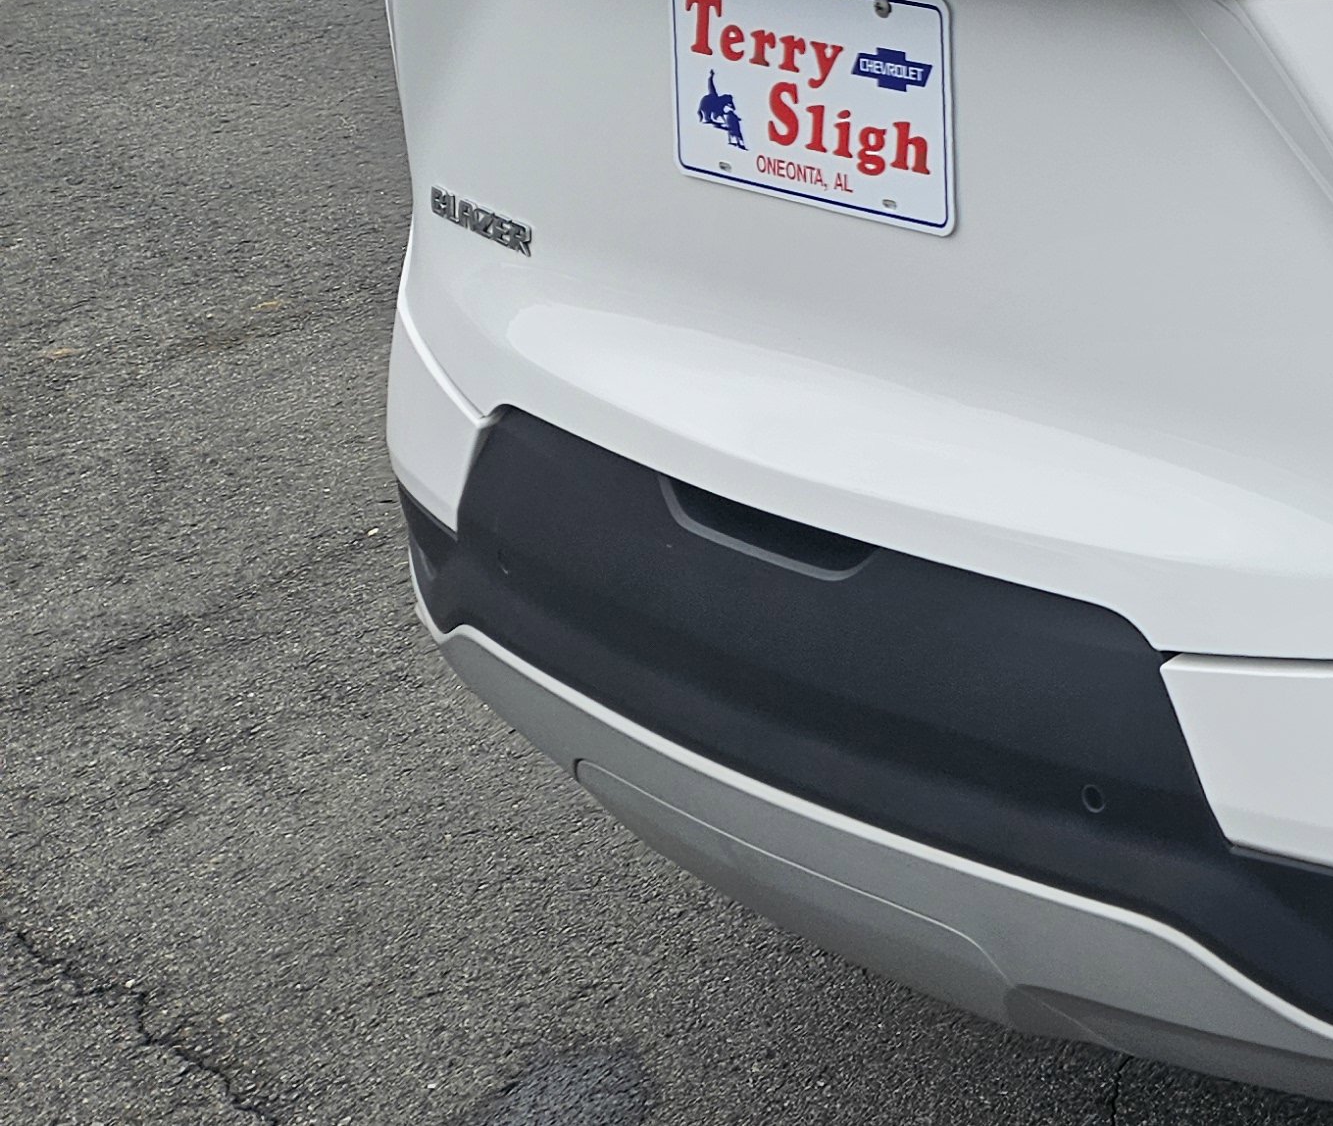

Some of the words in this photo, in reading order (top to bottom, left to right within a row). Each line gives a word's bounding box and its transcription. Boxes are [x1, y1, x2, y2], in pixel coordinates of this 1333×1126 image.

[859, 57, 924, 82] CHEVROLET
[767, 81, 931, 177] Sligh
[756, 155, 828, 191] ONEONTA,
[833, 172, 854, 194] AL
[430, 185, 532, 258] BLAZER
